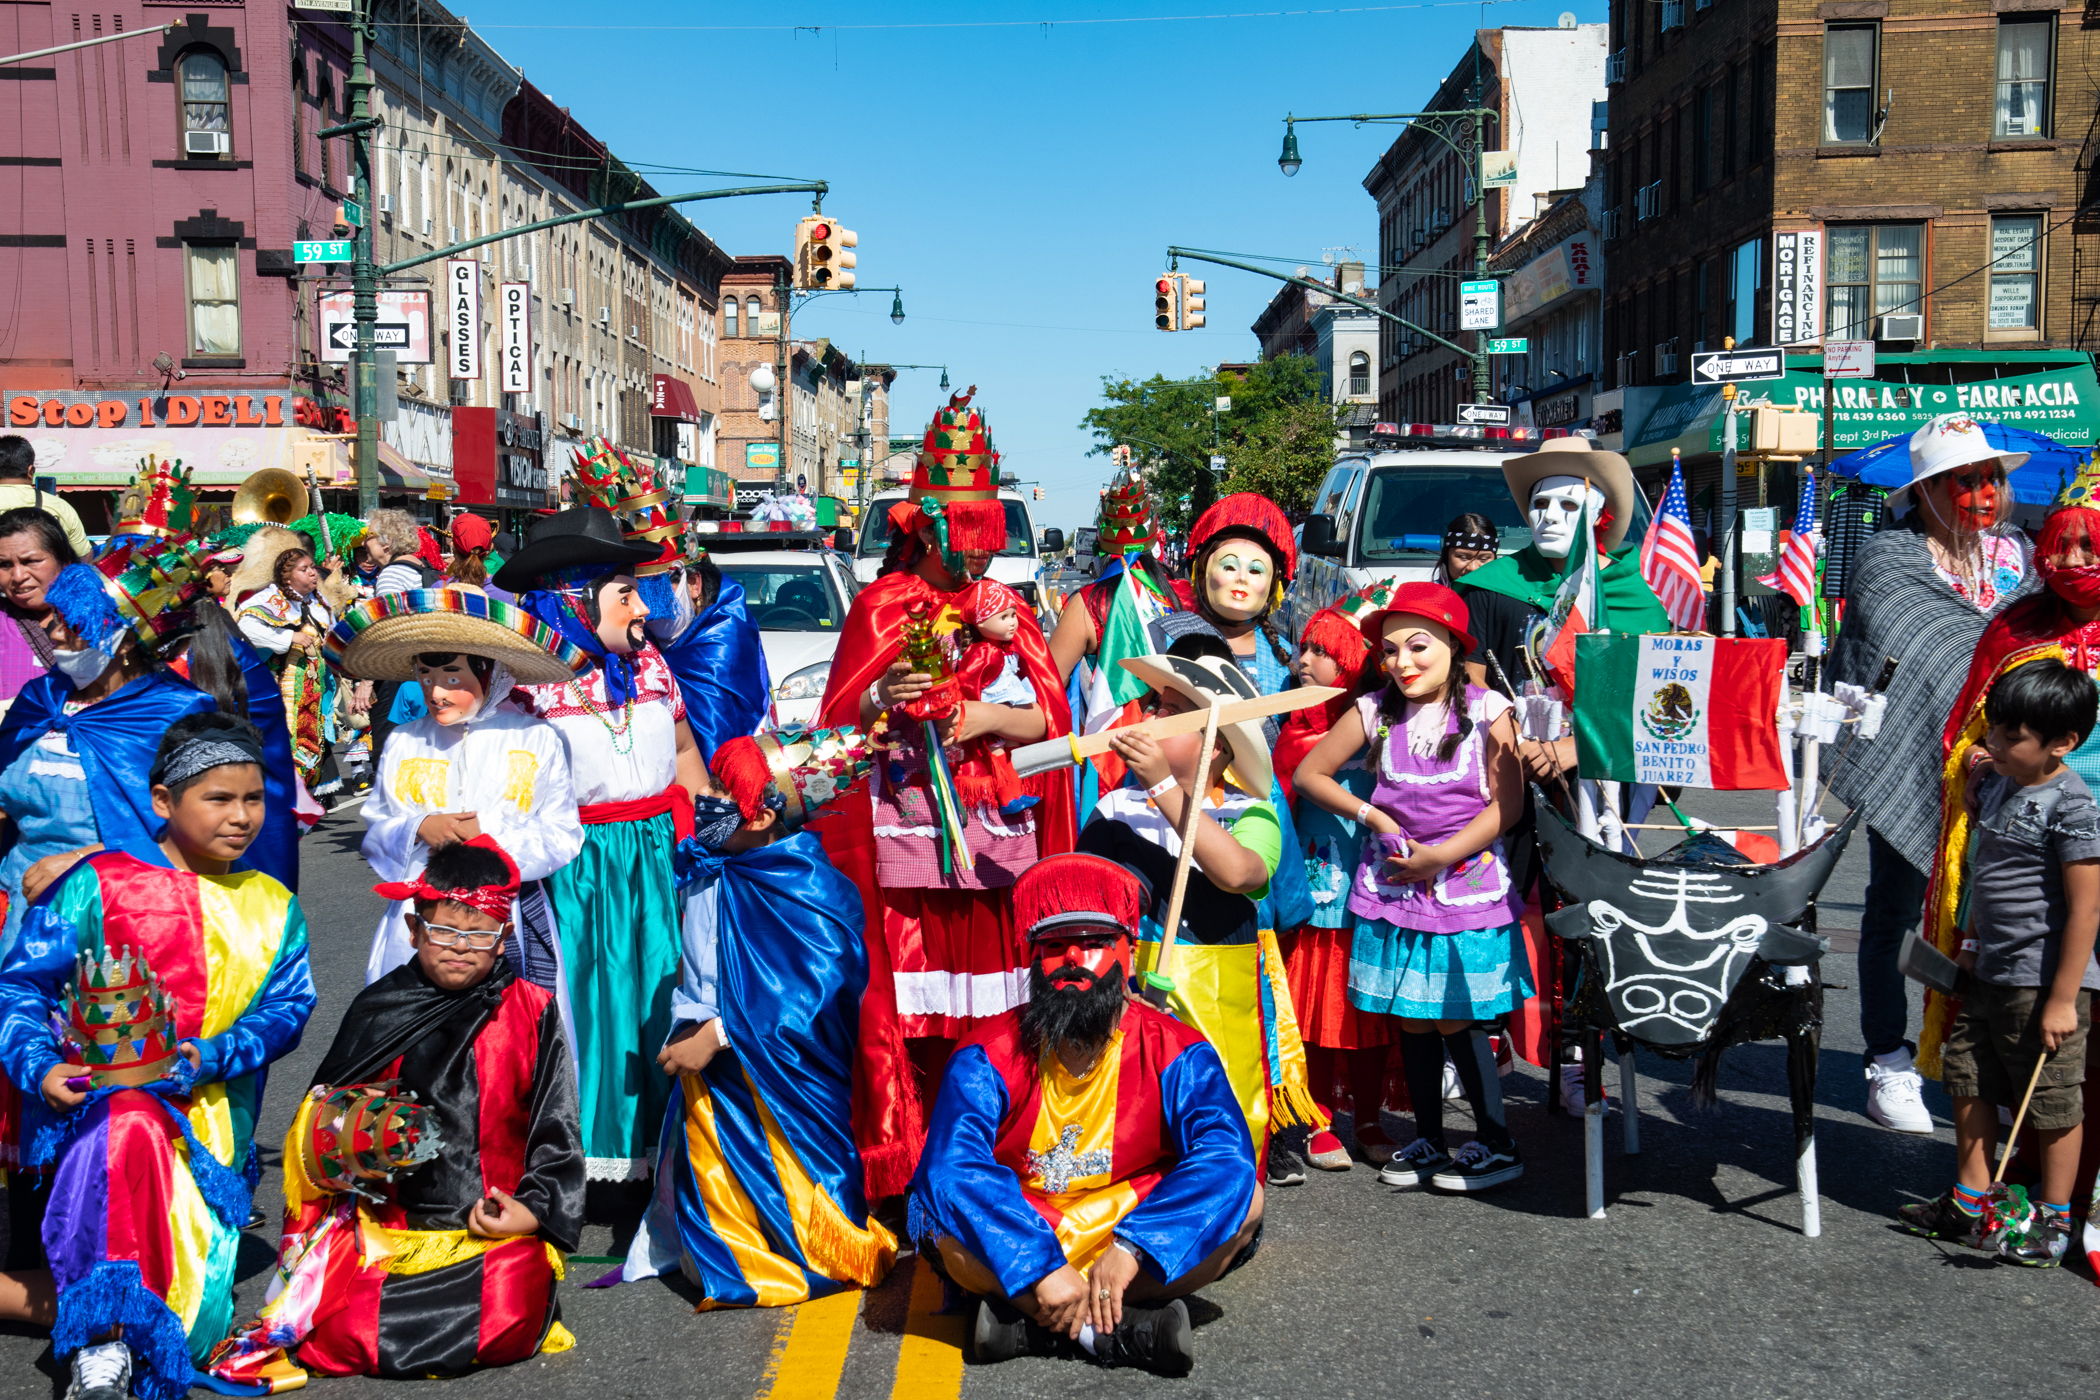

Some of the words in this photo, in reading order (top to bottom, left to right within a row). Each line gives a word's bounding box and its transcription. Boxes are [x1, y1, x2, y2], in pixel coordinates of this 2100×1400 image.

[2012, 227, 2030, 235] ESTATE
[303, 243, 323, 261] 59
[329, 243, 344, 255] ST
[1571, 242, 1591, 285] KARATE
[1778, 235, 1795, 342] MORTGAGE
[1801, 236, 1815, 340] REFINANCING
[381, 292, 426, 303] DELI
[1465, 307, 1495, 317] SHARED
[456, 266, 470, 373] GLASSES
[1469, 317, 1490, 325] LANE
[342, 331, 357, 341] ON
[375, 330, 400, 341] WAY
[508, 289, 522, 386] OPTICAL
[1494, 341, 1507, 352] 59
[1511, 340, 1521, 349] ST
[1837, 345, 1862, 353] PARKING
[1828, 354, 1851, 363] Anytime
[1707, 361, 1732, 374] ONE
[1744, 358, 1771, 371] WAY
[656, 381, 666, 409] PIZZA
[1956, 382, 2080, 408] FARMACIA
[10, 395, 128, 428] Stop
[138, 397, 156, 426] 1
[165, 395, 285, 426] DELI
[1467, 410, 1482, 418] ONE
[1488, 411, 1503, 420] WAY
[1832, 412, 1850, 421] 718
[1852, 412, 1874, 421] 439
[1877, 412, 1906, 421] 6360
[1970, 412, 1992, 420] FAX
[2002, 411, 2022, 420] 718
[2024, 410, 2047, 419] 492
[2048, 409, 2075, 419] 1234
[1818, 430, 1859, 444] Acept
[1862, 429, 1879, 442] 3rd
[753, 455, 773, 463] Deli
[76, 472, 96, 484] Cigar
[98, 472, 112, 482] Hot
[195, 471, 211, 481] Line
[212, 471, 222, 481] Of
[510, 455, 532, 488] VISION
[1651, 638, 1703, 651] MORAS
[1673, 655, 1682, 668] Y
[1652, 668, 1698, 682] WISOS
[1635, 741, 1663, 754] SAN
[1663, 742, 1707, 755] PEDRO
[1642, 755, 1696, 770] BENITO
[1641, 770, 1695, 784] JUAREZ
